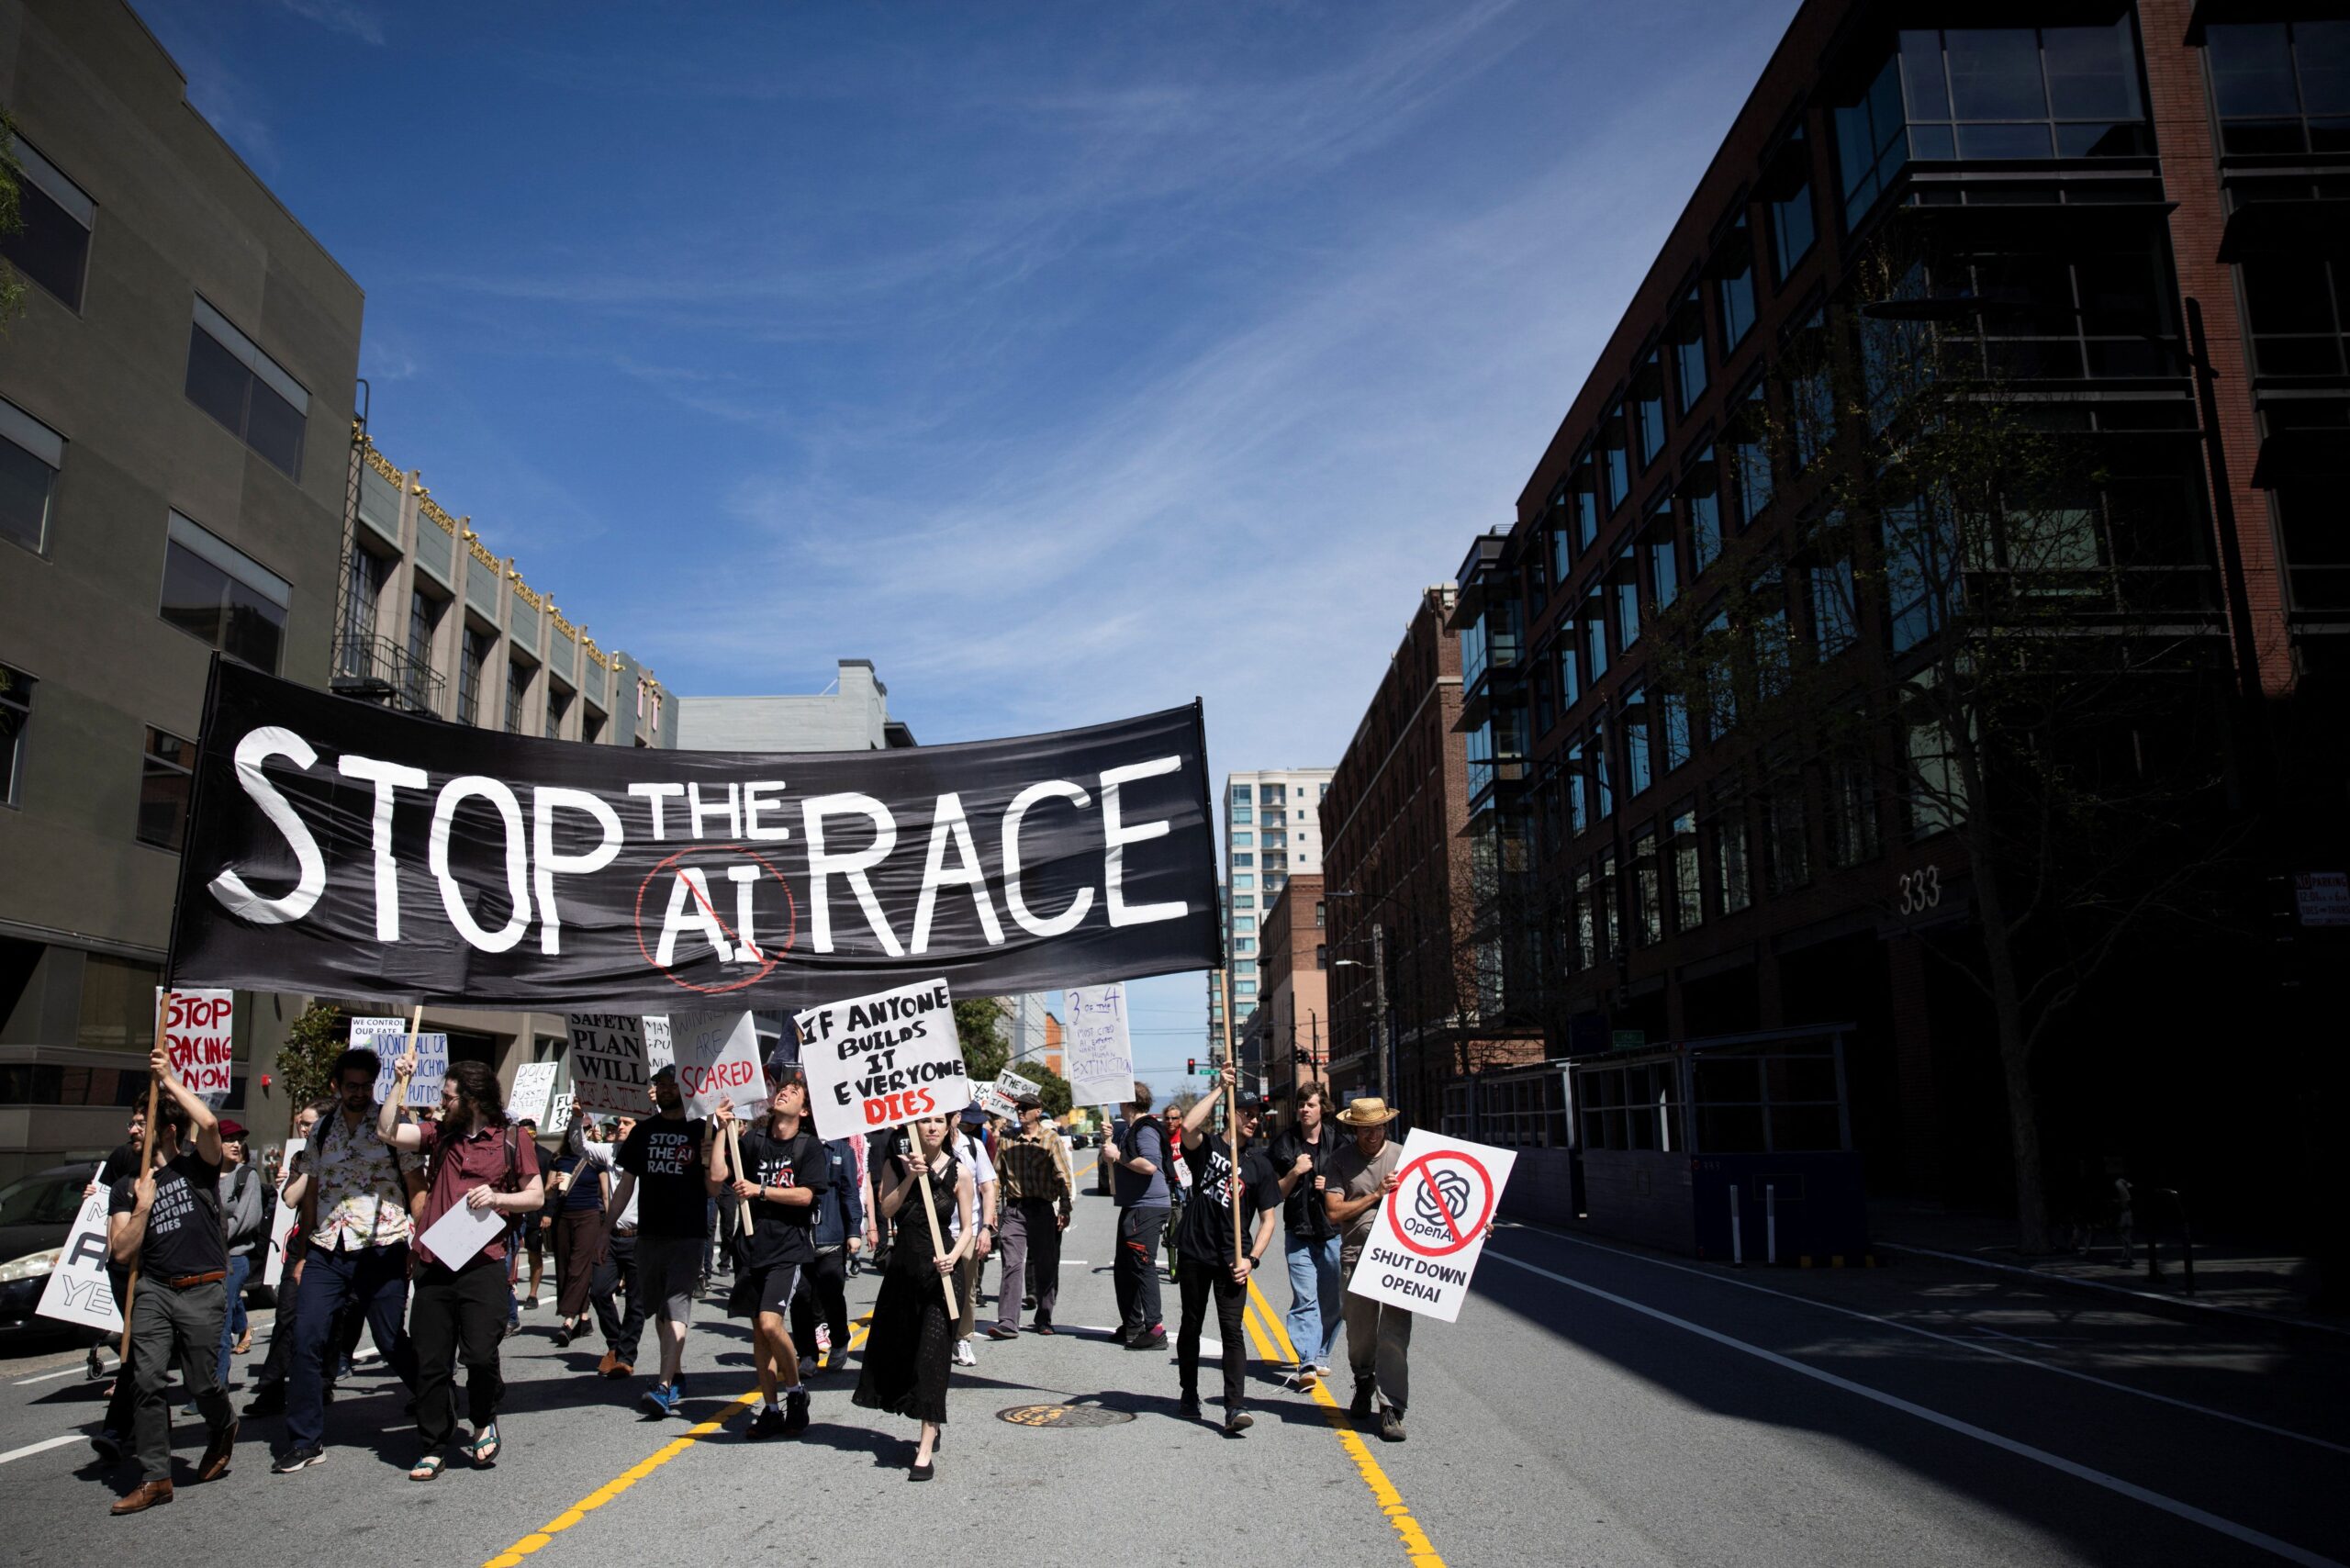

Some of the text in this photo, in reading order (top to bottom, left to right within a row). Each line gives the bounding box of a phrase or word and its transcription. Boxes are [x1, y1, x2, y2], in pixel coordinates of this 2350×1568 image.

[207, 726, 1189, 966] STOP THE AI RACE
[1899, 865, 1941, 915] 333
[160, 993, 232, 1029] STOP
[801, 986, 949, 1046] IF ANYONE
[1104, 987, 1120, 1017] 4
[571, 1014, 639, 1033] SAFETY
[166, 1035, 231, 1073] RACING
[433, 1035, 446, 1053] UP
[572, 1028, 642, 1059] PLAN
[696, 1029, 723, 1059] ARE
[837, 1020, 928, 1060] BUILDS
[576, 1054, 648, 1085] WILL
[864, 1048, 896, 1075] IT
[1072, 1057, 1132, 1080] EXTINCTION
[183, 1066, 229, 1092] NOW
[681, 1061, 753, 1098] SCARED
[834, 1059, 965, 1106] EVERYONE
[1002, 1072, 1022, 1090] THE
[556, 1095, 572, 1107] FU
[556, 1108, 572, 1118] TH
[577, 1081, 653, 1115] FAIL
[863, 1087, 935, 1126] DIES
[554, 1116, 570, 1130] SH
[647, 1147, 692, 1161] THE AI
[649, 1133, 688, 1146] STOP
[900, 1138, 910, 1147] ST
[647, 1160, 684, 1174] RACE
[1370, 1248, 1467, 1286] SHUT DOWN
[1381, 1274, 1442, 1304] OPENAI
